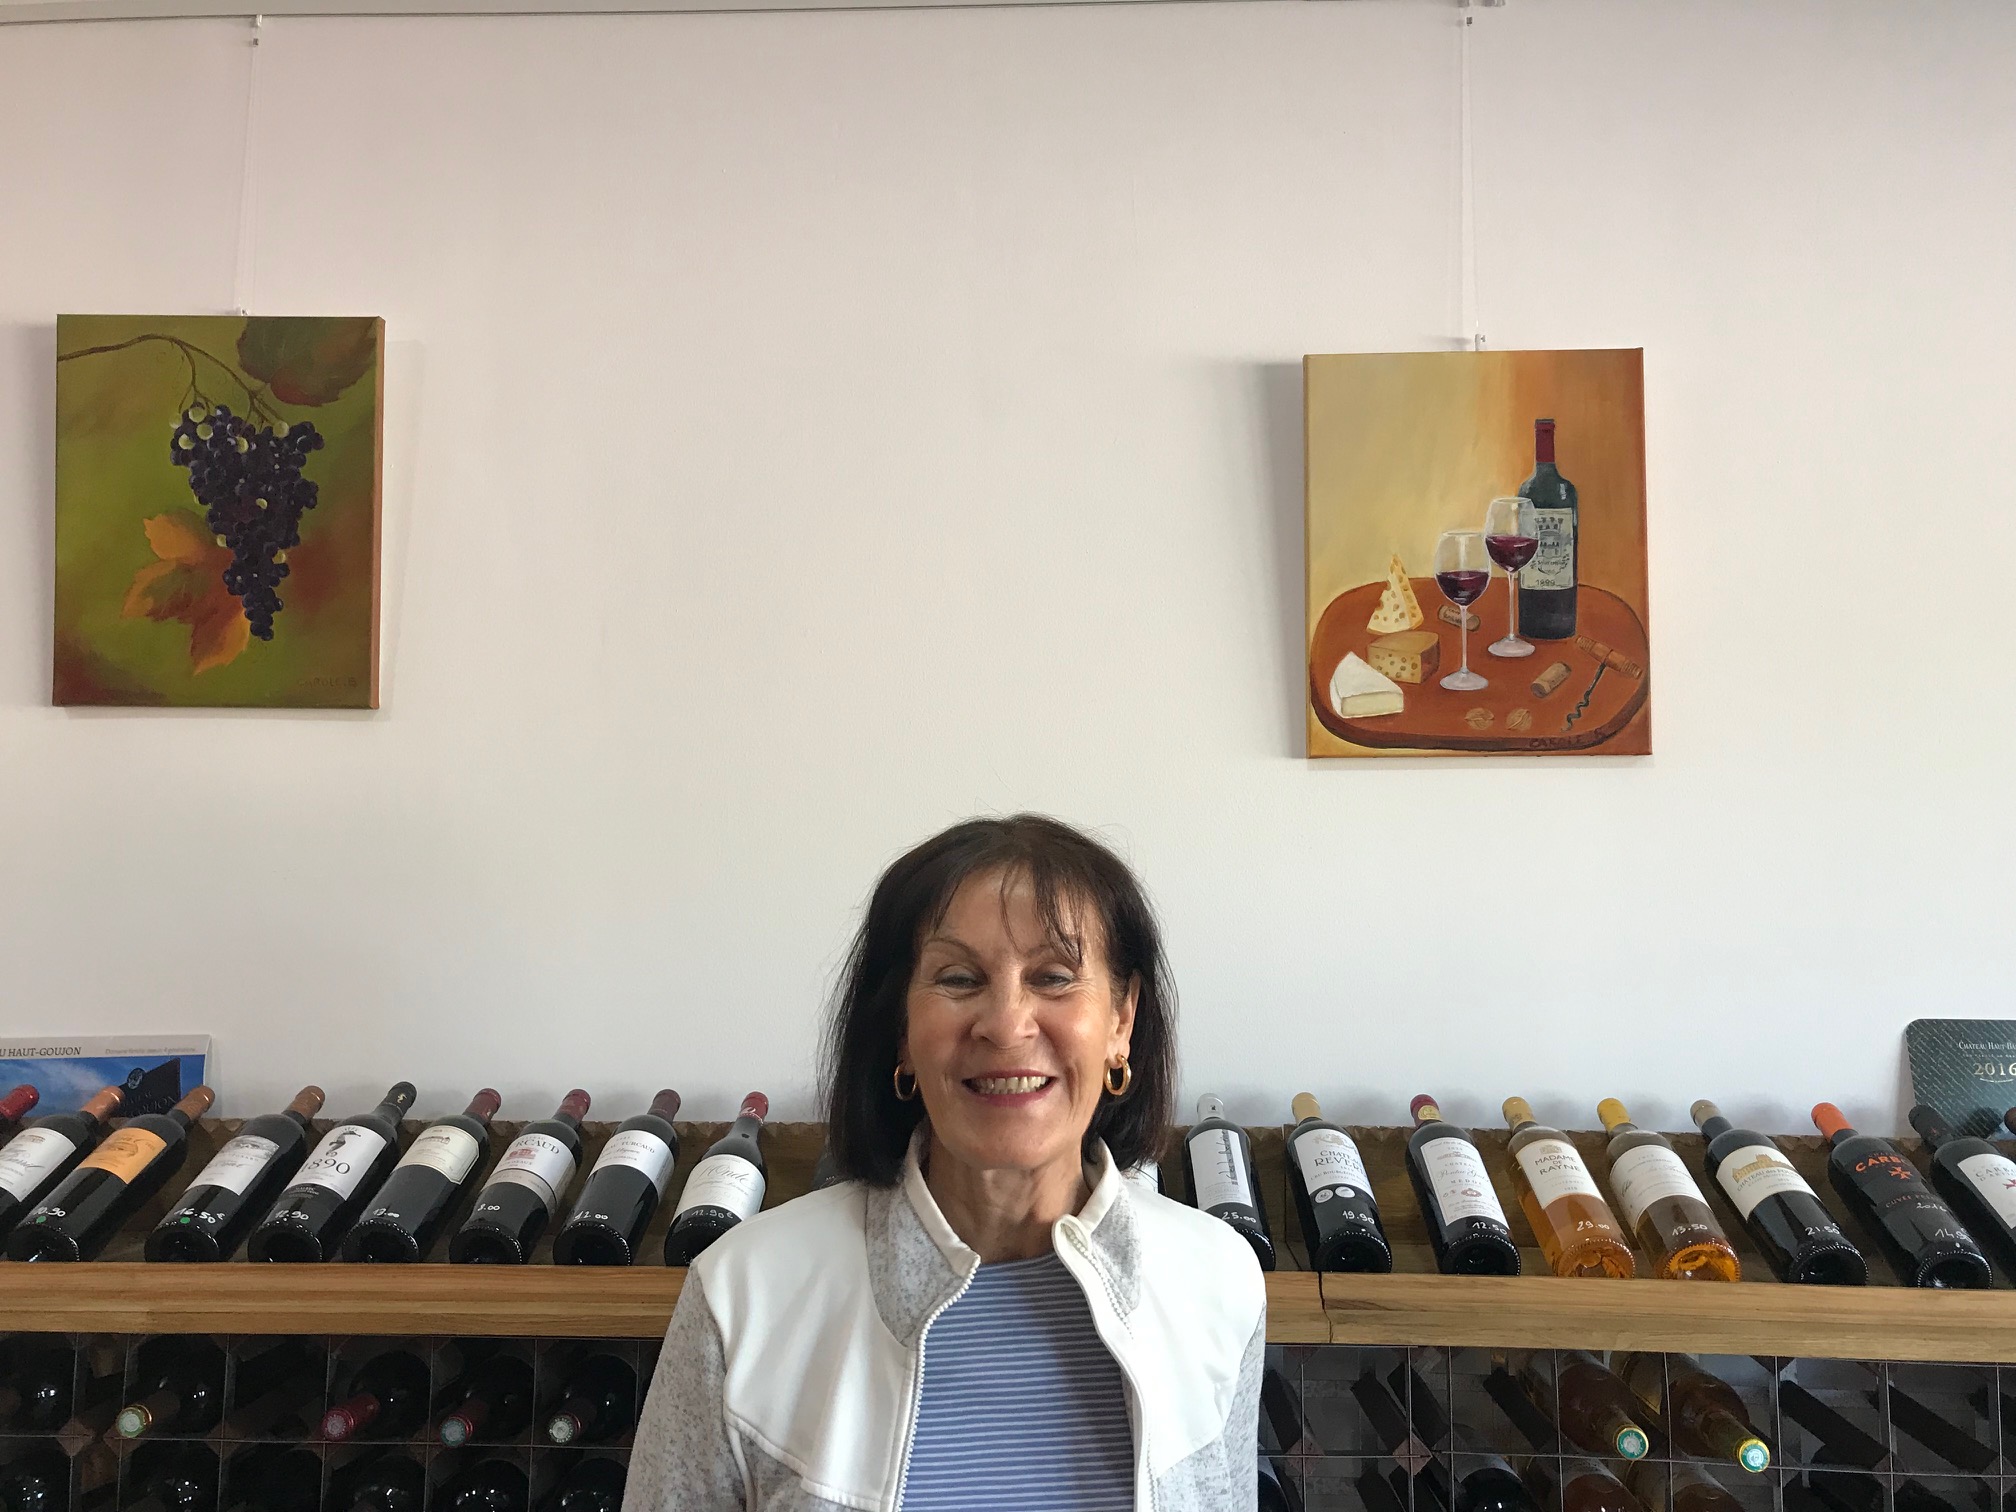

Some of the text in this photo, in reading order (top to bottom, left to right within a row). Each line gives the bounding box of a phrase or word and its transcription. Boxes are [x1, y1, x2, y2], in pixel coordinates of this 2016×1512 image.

[8, 1046, 82, 1057] HAUT-GOUJON
[1973, 1063, 2016, 1076] 2016
[301, 1158, 351, 1175] 1890
[1535, 1155, 1576, 1166] MADAME
[1540, 1164, 1581, 1175] RAYNE
[1221, 1211, 1257, 1224] 25.00
[1342, 1210, 1375, 1225] 19.90
[1471, 1221, 1508, 1236] 12.50
[1576, 1220, 1610, 1232] 29.00
[1672, 1223, 1708, 1237] 13.50
